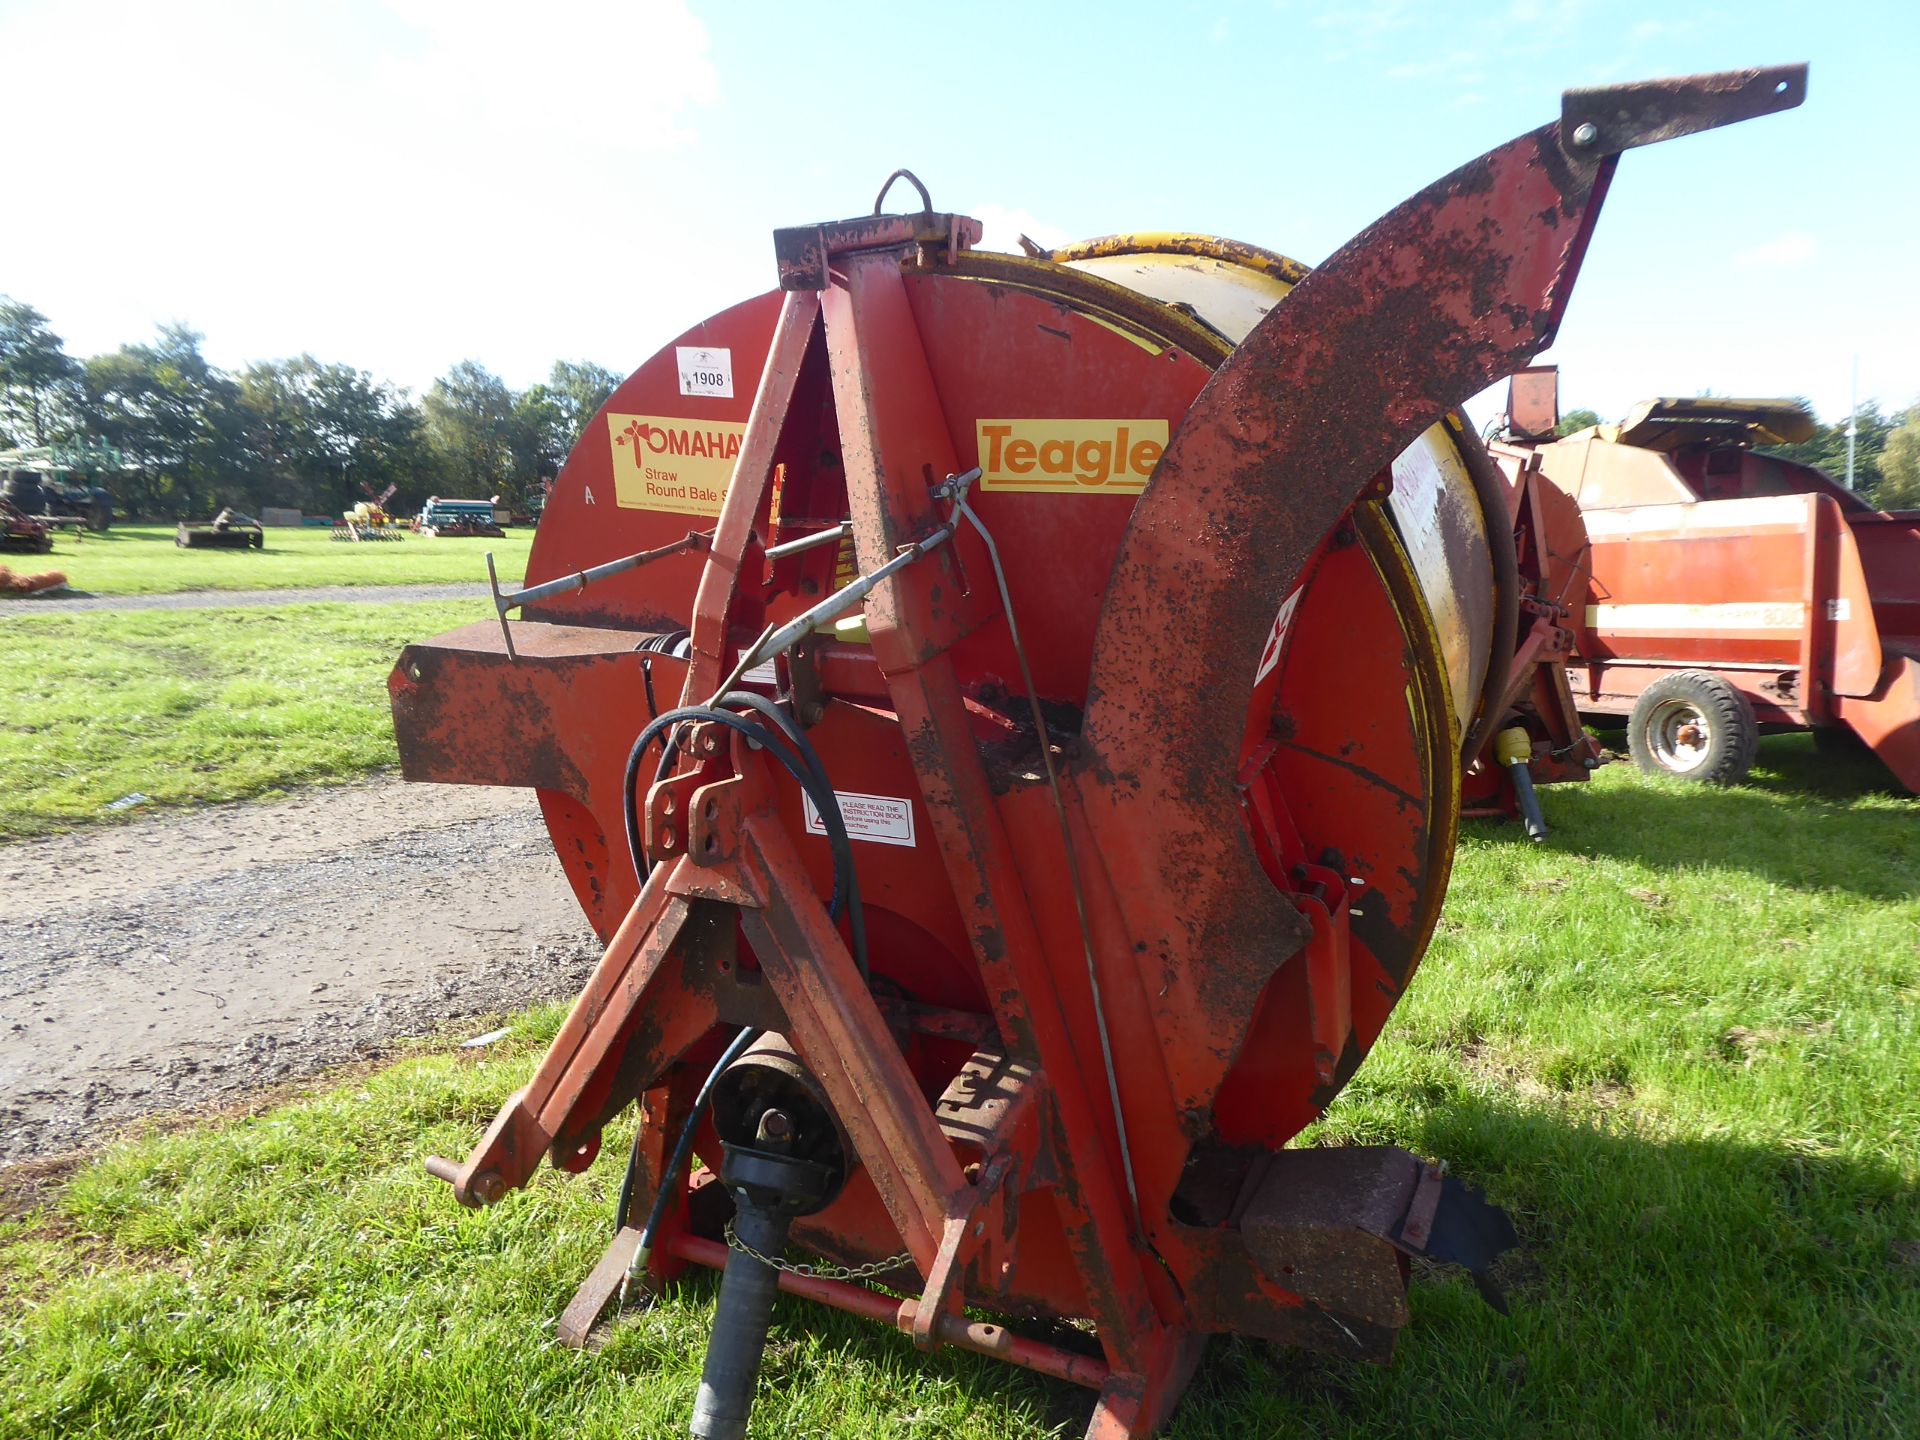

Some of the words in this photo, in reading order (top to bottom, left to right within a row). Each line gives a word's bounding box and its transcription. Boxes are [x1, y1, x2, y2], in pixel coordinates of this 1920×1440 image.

[693, 371, 724, 387] 1908
[620, 420, 743, 468] TOMAHA
[982, 425, 1164, 486] Teagle
[645, 468, 678, 482] Straw
[646, 482, 686, 499] Round
[690, 487, 717, 502] Bale
[842, 801, 866, 810] PLEASE
[843, 808, 884, 818] INSTRUCTION
